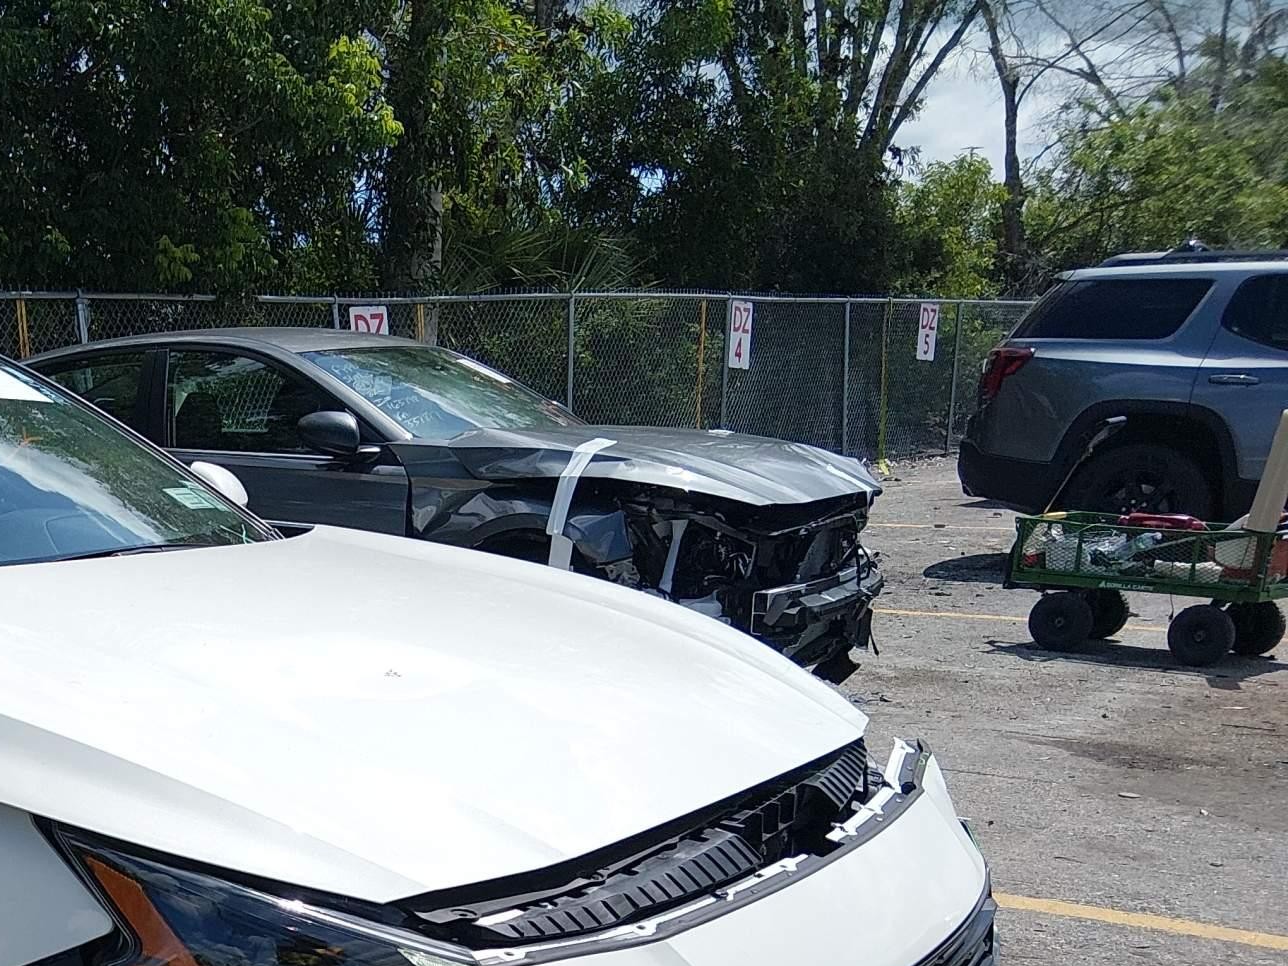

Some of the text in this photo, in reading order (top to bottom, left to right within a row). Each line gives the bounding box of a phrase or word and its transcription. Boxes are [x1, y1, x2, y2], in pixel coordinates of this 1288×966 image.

[733, 306, 750, 334] DZ
[921, 307, 937, 331] DZ
[734, 337, 742, 363] 4
[923, 334, 930, 355] 5
